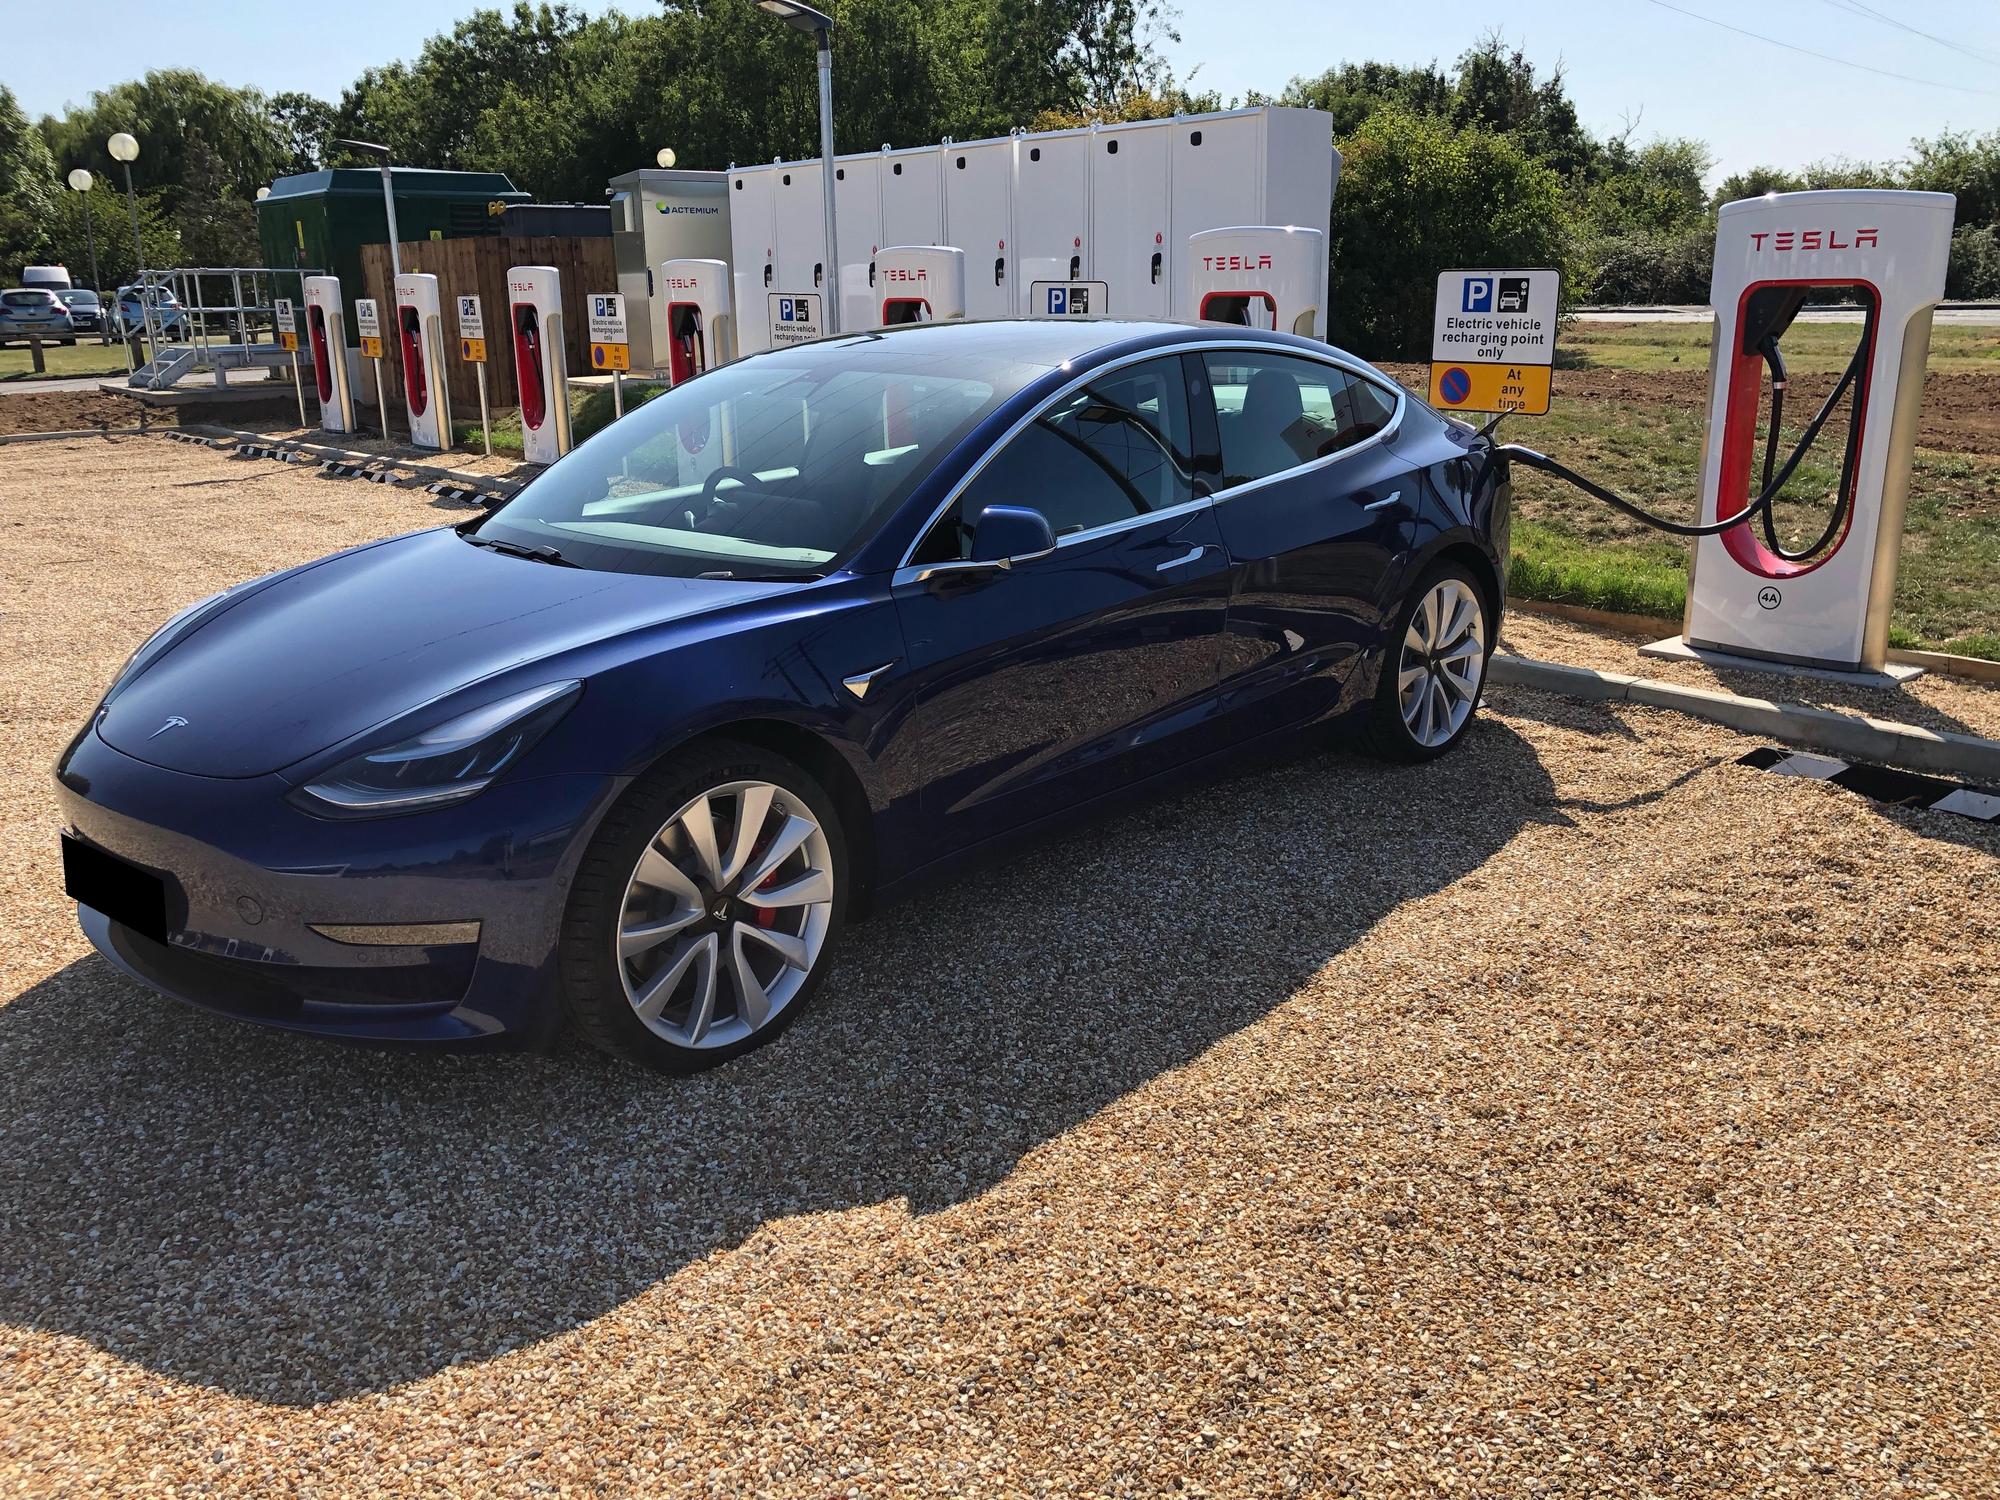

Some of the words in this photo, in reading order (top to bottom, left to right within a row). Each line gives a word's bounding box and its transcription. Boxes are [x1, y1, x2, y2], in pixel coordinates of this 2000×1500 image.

[671, 206, 719, 215] ACTEMIUM
[1750, 228, 1879, 252] TESLA
[1203, 255, 1272, 271] TESLA
[882, 269, 927, 281] TESLA
[510, 282, 534, 291] TESLA
[666, 278, 698, 289] TESLA
[1051, 290, 1064, 313] P
[1468, 280, 1489, 310] P
[782, 300, 792, 320] P
[592, 318, 608, 327] Electric
[607, 319, 622, 327] vehicle
[775, 323, 796, 332] Electric
[796, 325, 816, 333] vehicle
[1446, 317, 1493, 330] Electric
[1495, 318, 1541, 330] vehicle
[591, 327, 613, 335] recharging
[613, 327, 625, 335] point
[1442, 332, 1508, 347] recharging
[1510, 333, 1544, 347] point
[1477, 346, 1504, 361] only
[1506, 368, 1522, 381] At
[1501, 385, 1525, 398] any
[1498, 397, 1526, 410] time
[1761, 592, 1778, 604] 4A
